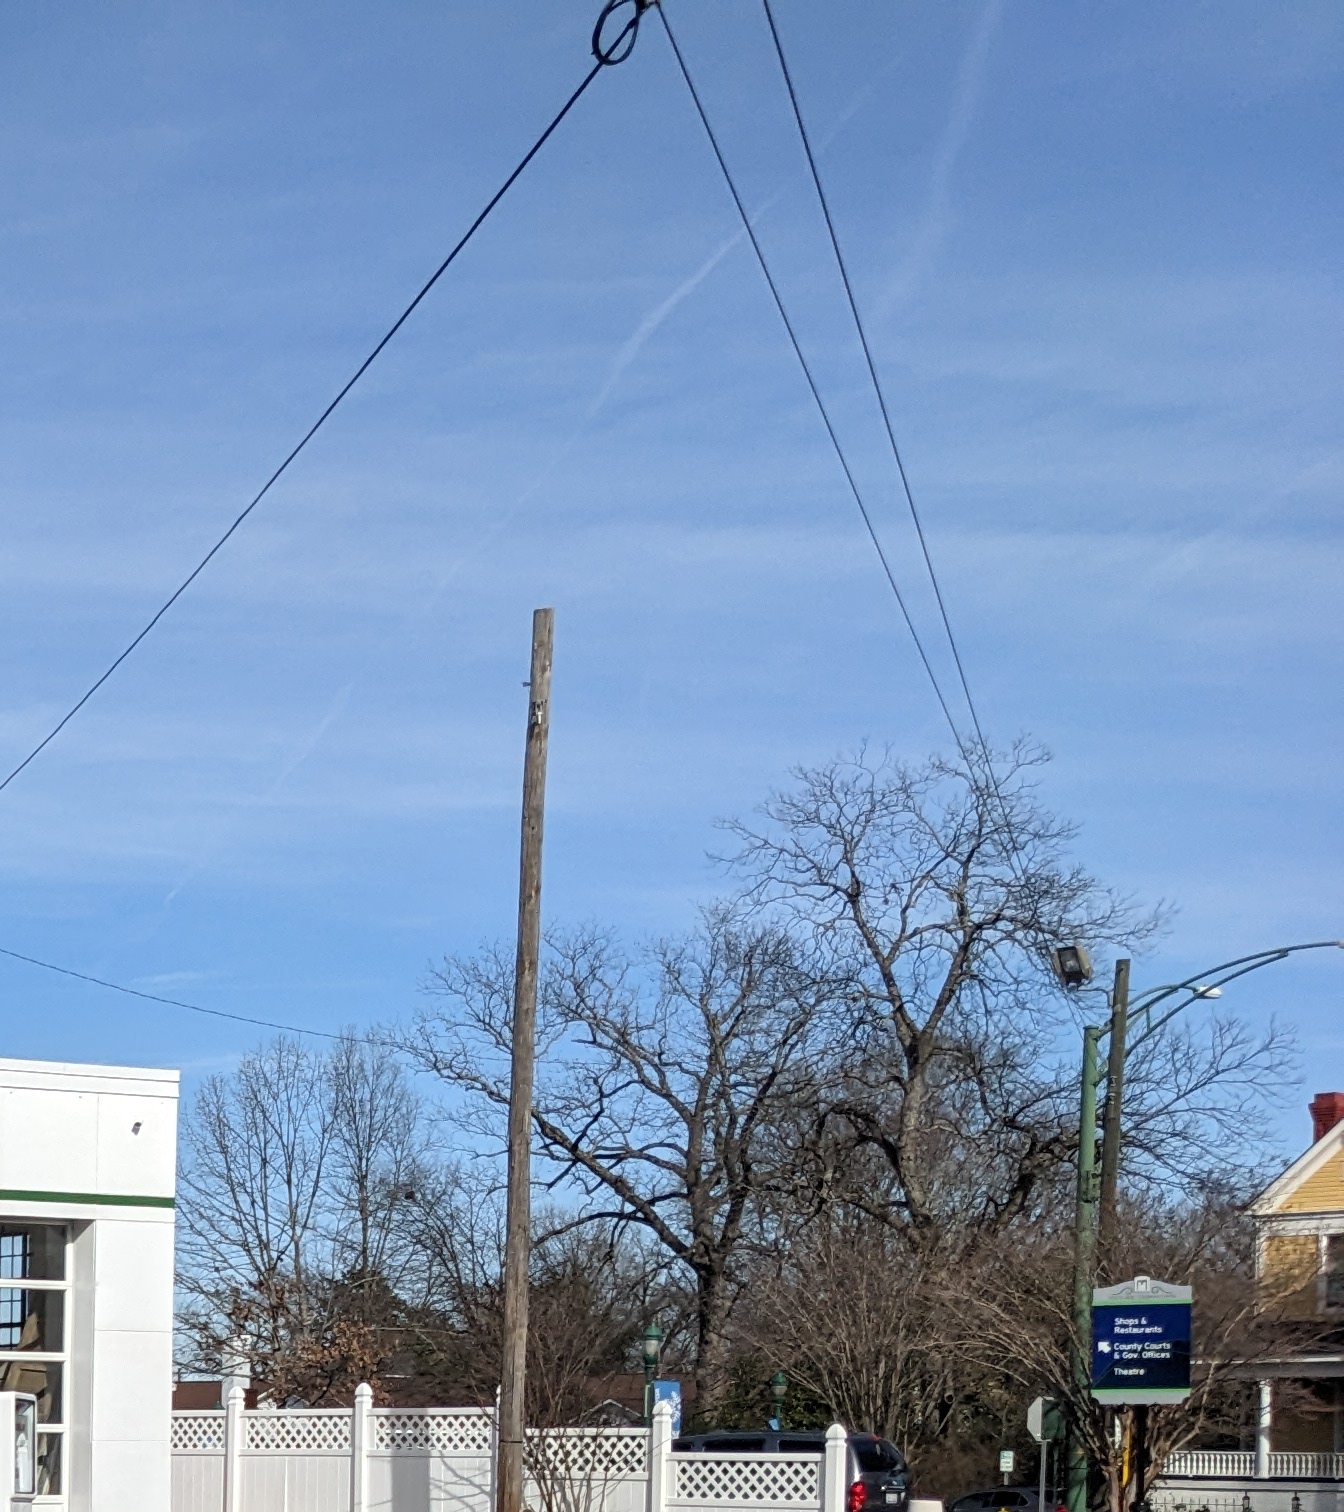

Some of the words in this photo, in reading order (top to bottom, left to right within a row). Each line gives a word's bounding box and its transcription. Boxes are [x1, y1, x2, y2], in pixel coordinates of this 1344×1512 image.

[1114, 1317, 1139, 1326] Shops
[1141, 1316, 1147, 1325] &
[1114, 1326, 1163, 1334] Restaurants
[1113, 1342, 1143, 1352] County
[1144, 1342, 1171, 1350] Courts
[1141, 1350, 1171, 1359] Offices
[1113, 1367, 1145, 1376] Theatre
